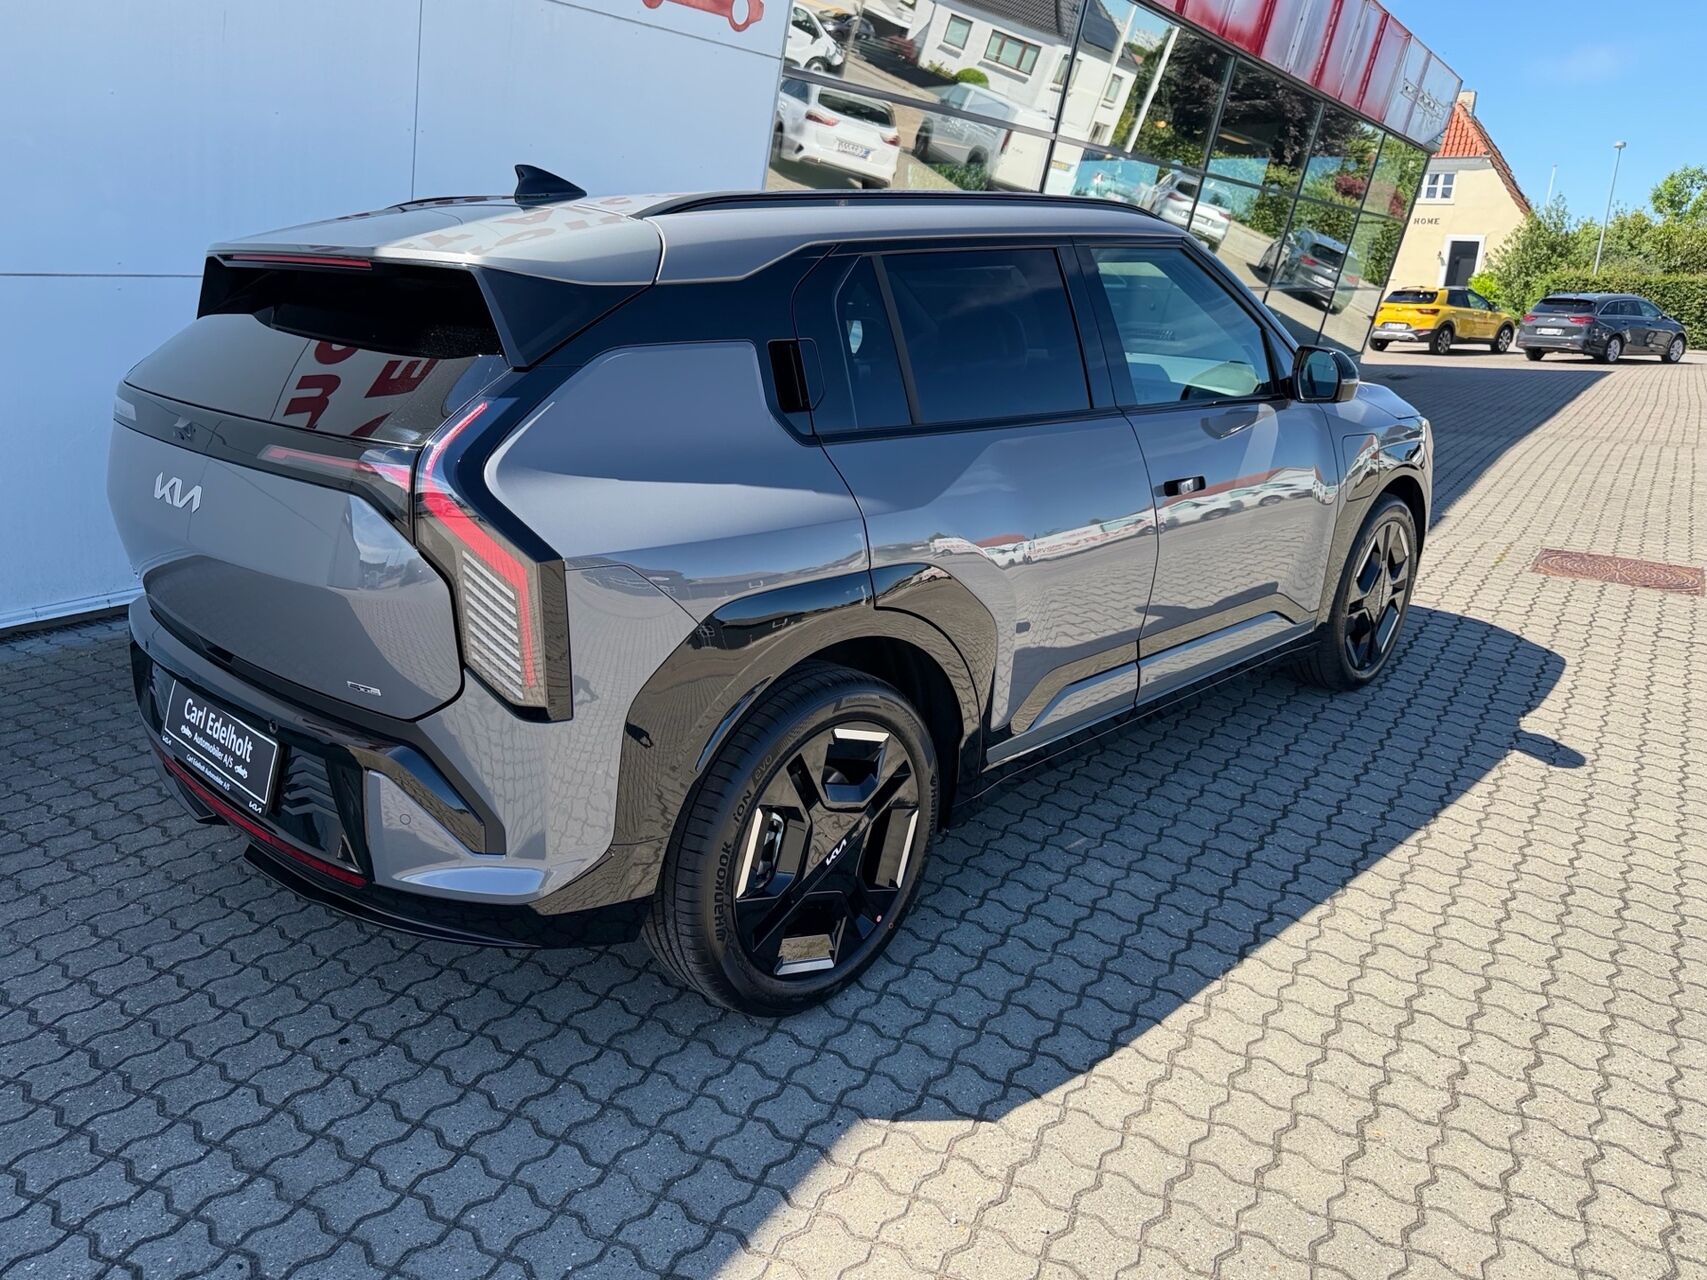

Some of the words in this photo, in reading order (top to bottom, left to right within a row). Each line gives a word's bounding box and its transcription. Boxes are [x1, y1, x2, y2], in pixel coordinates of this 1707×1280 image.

[1413, 217, 1440, 225] HOME
[154, 471, 202, 513] KIA
[185, 698, 207, 729] Carl
[206, 712, 253, 762] Edelholt
[193, 732, 224, 760] Automobiler
[223, 754, 234, 768] A/S
[249, 801, 262, 813] KIA
[825, 838, 847, 866] KIA
